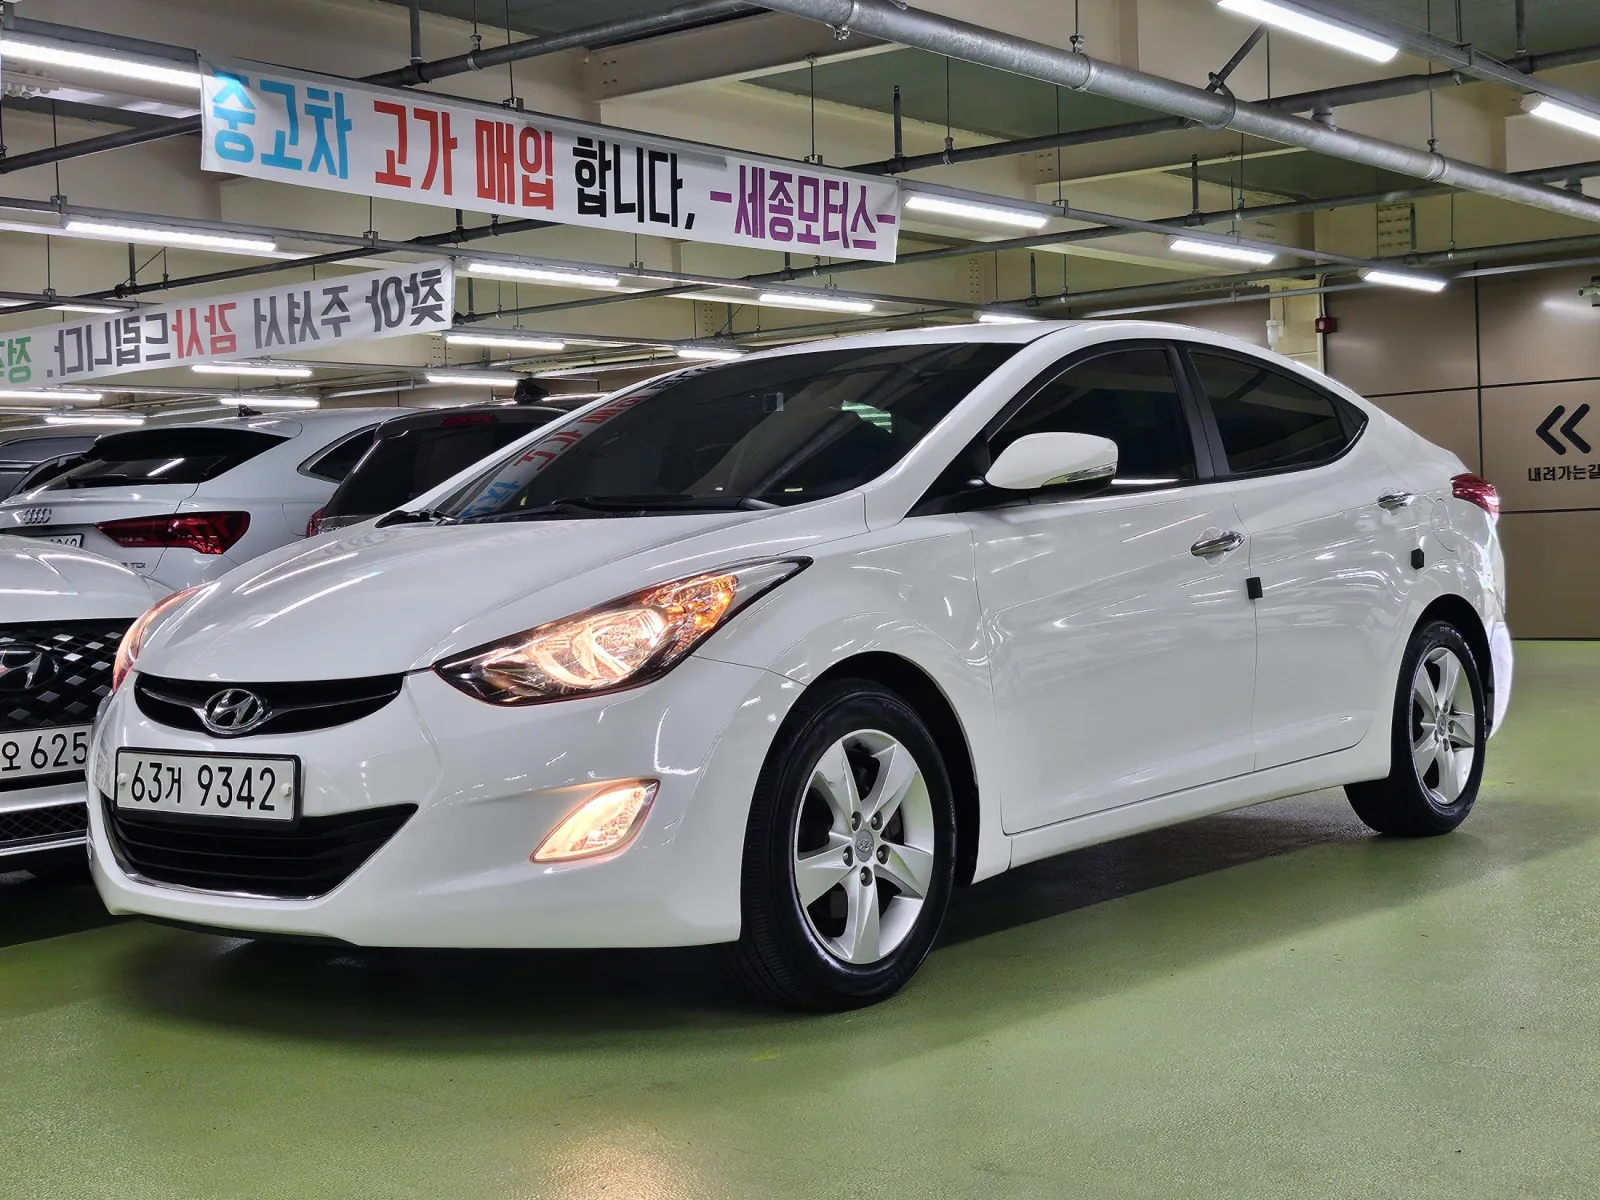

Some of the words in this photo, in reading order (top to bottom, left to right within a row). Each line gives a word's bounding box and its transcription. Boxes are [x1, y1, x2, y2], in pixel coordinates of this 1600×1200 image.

[211, 68, 352, 180] 중고차
[373, 100, 457, 196] 고가
[475, 118, 554, 211] 매입
[572, 136, 696, 230] 합니다,
[1, 740, 22, 772] 오
[131, 760, 183, 804] 63거
[197, 764, 277, 812] 9342
